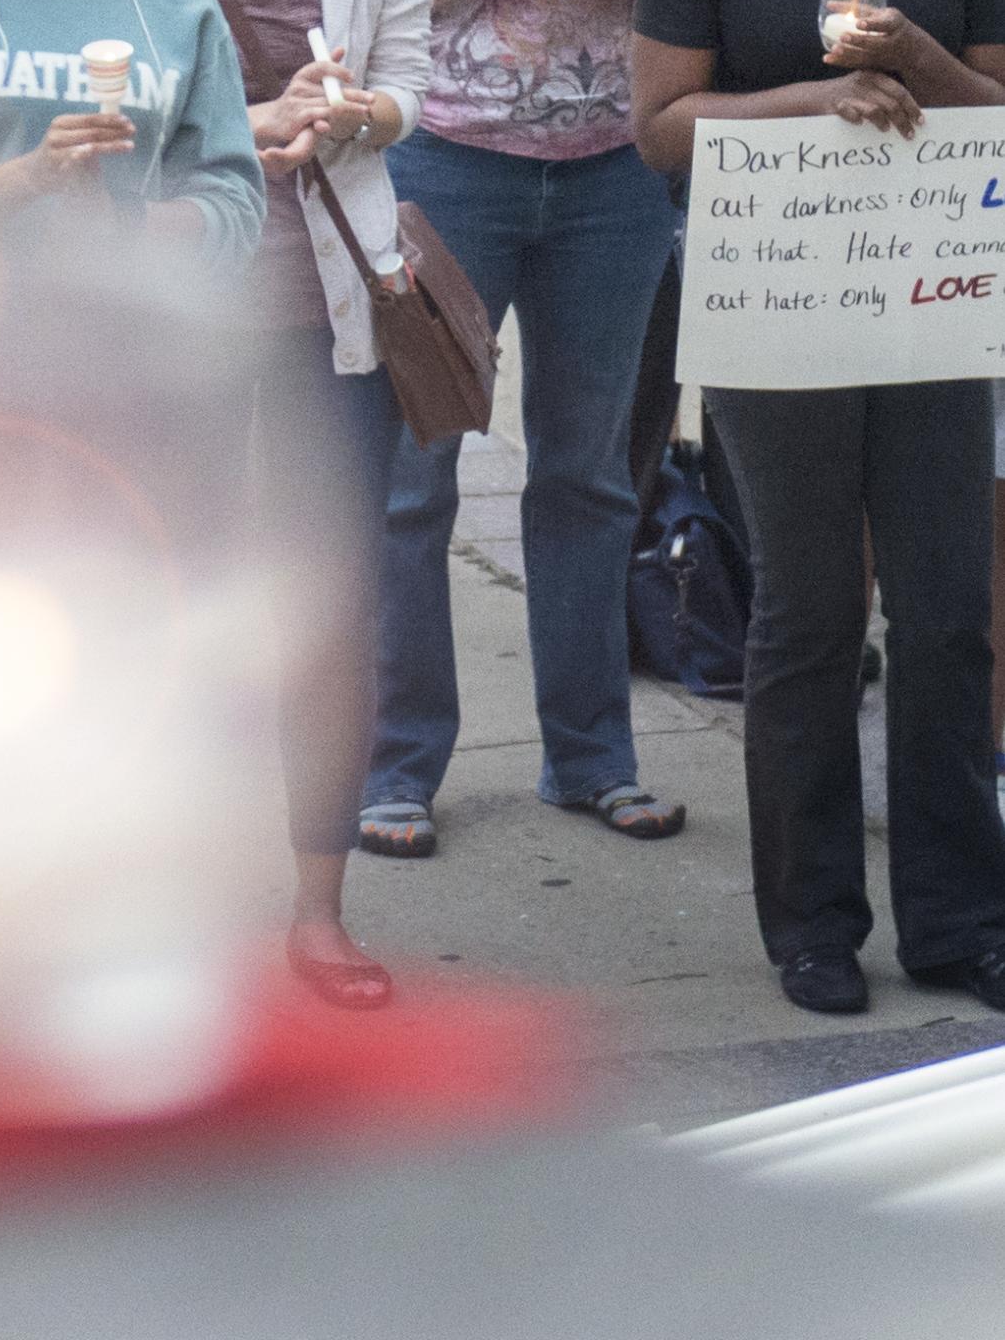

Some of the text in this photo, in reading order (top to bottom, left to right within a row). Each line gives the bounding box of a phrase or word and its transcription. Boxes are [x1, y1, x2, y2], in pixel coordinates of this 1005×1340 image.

[710, 193, 764, 218] out
[909, 184, 968, 222] only
[711, 237, 740, 262] do
[755, 238, 819, 262] that.
[846, 231, 913, 264] Hate
[705, 273, 998, 317] out hate: only LOVE
